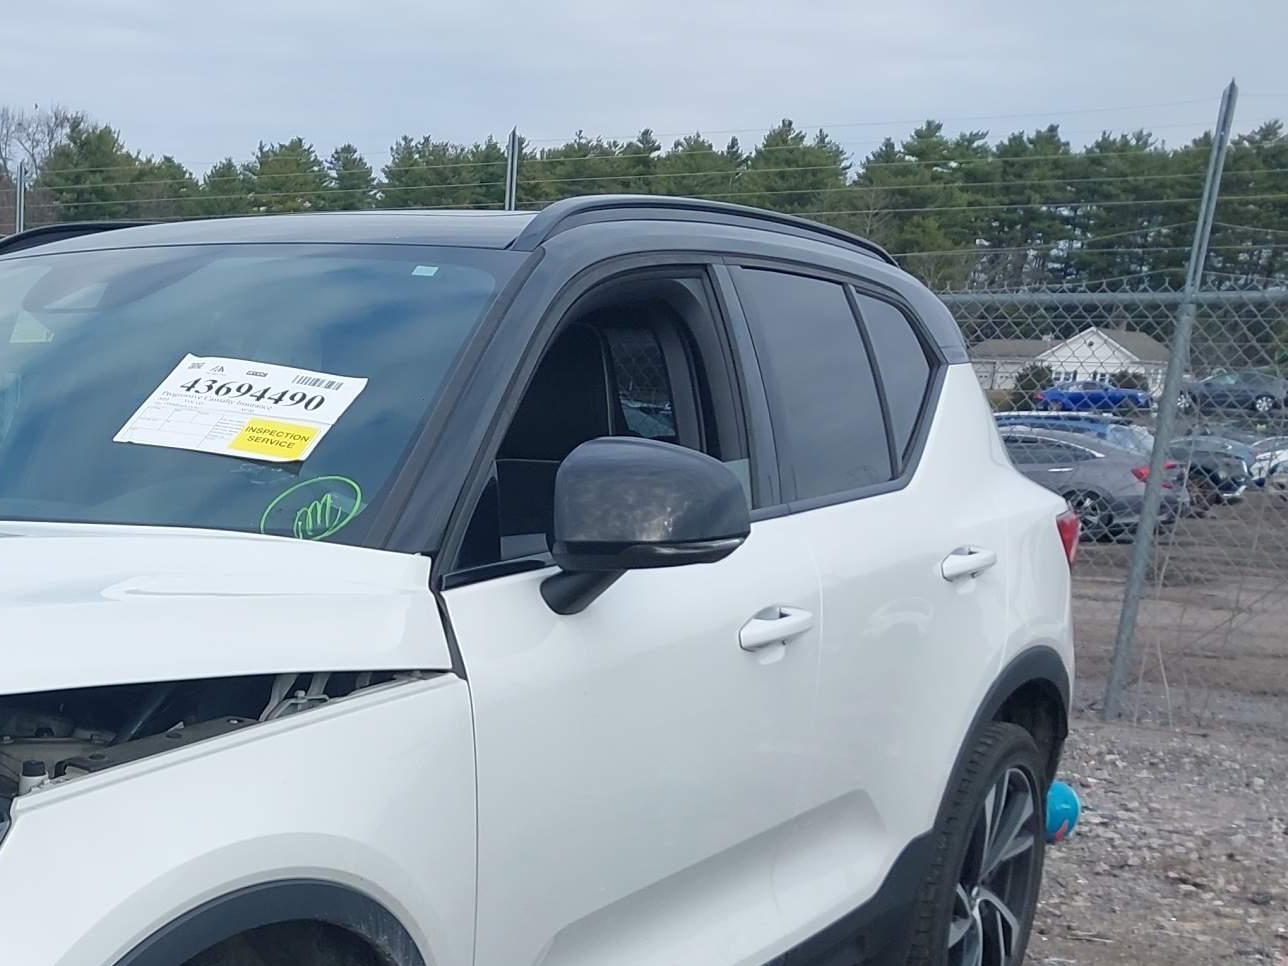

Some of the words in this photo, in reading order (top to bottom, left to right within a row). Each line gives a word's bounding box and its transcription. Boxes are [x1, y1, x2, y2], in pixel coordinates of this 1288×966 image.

[180, 377, 326, 412] 43694490
[245, 425, 311, 443] INSPECTION
[247, 435, 297, 450] SERVICE
